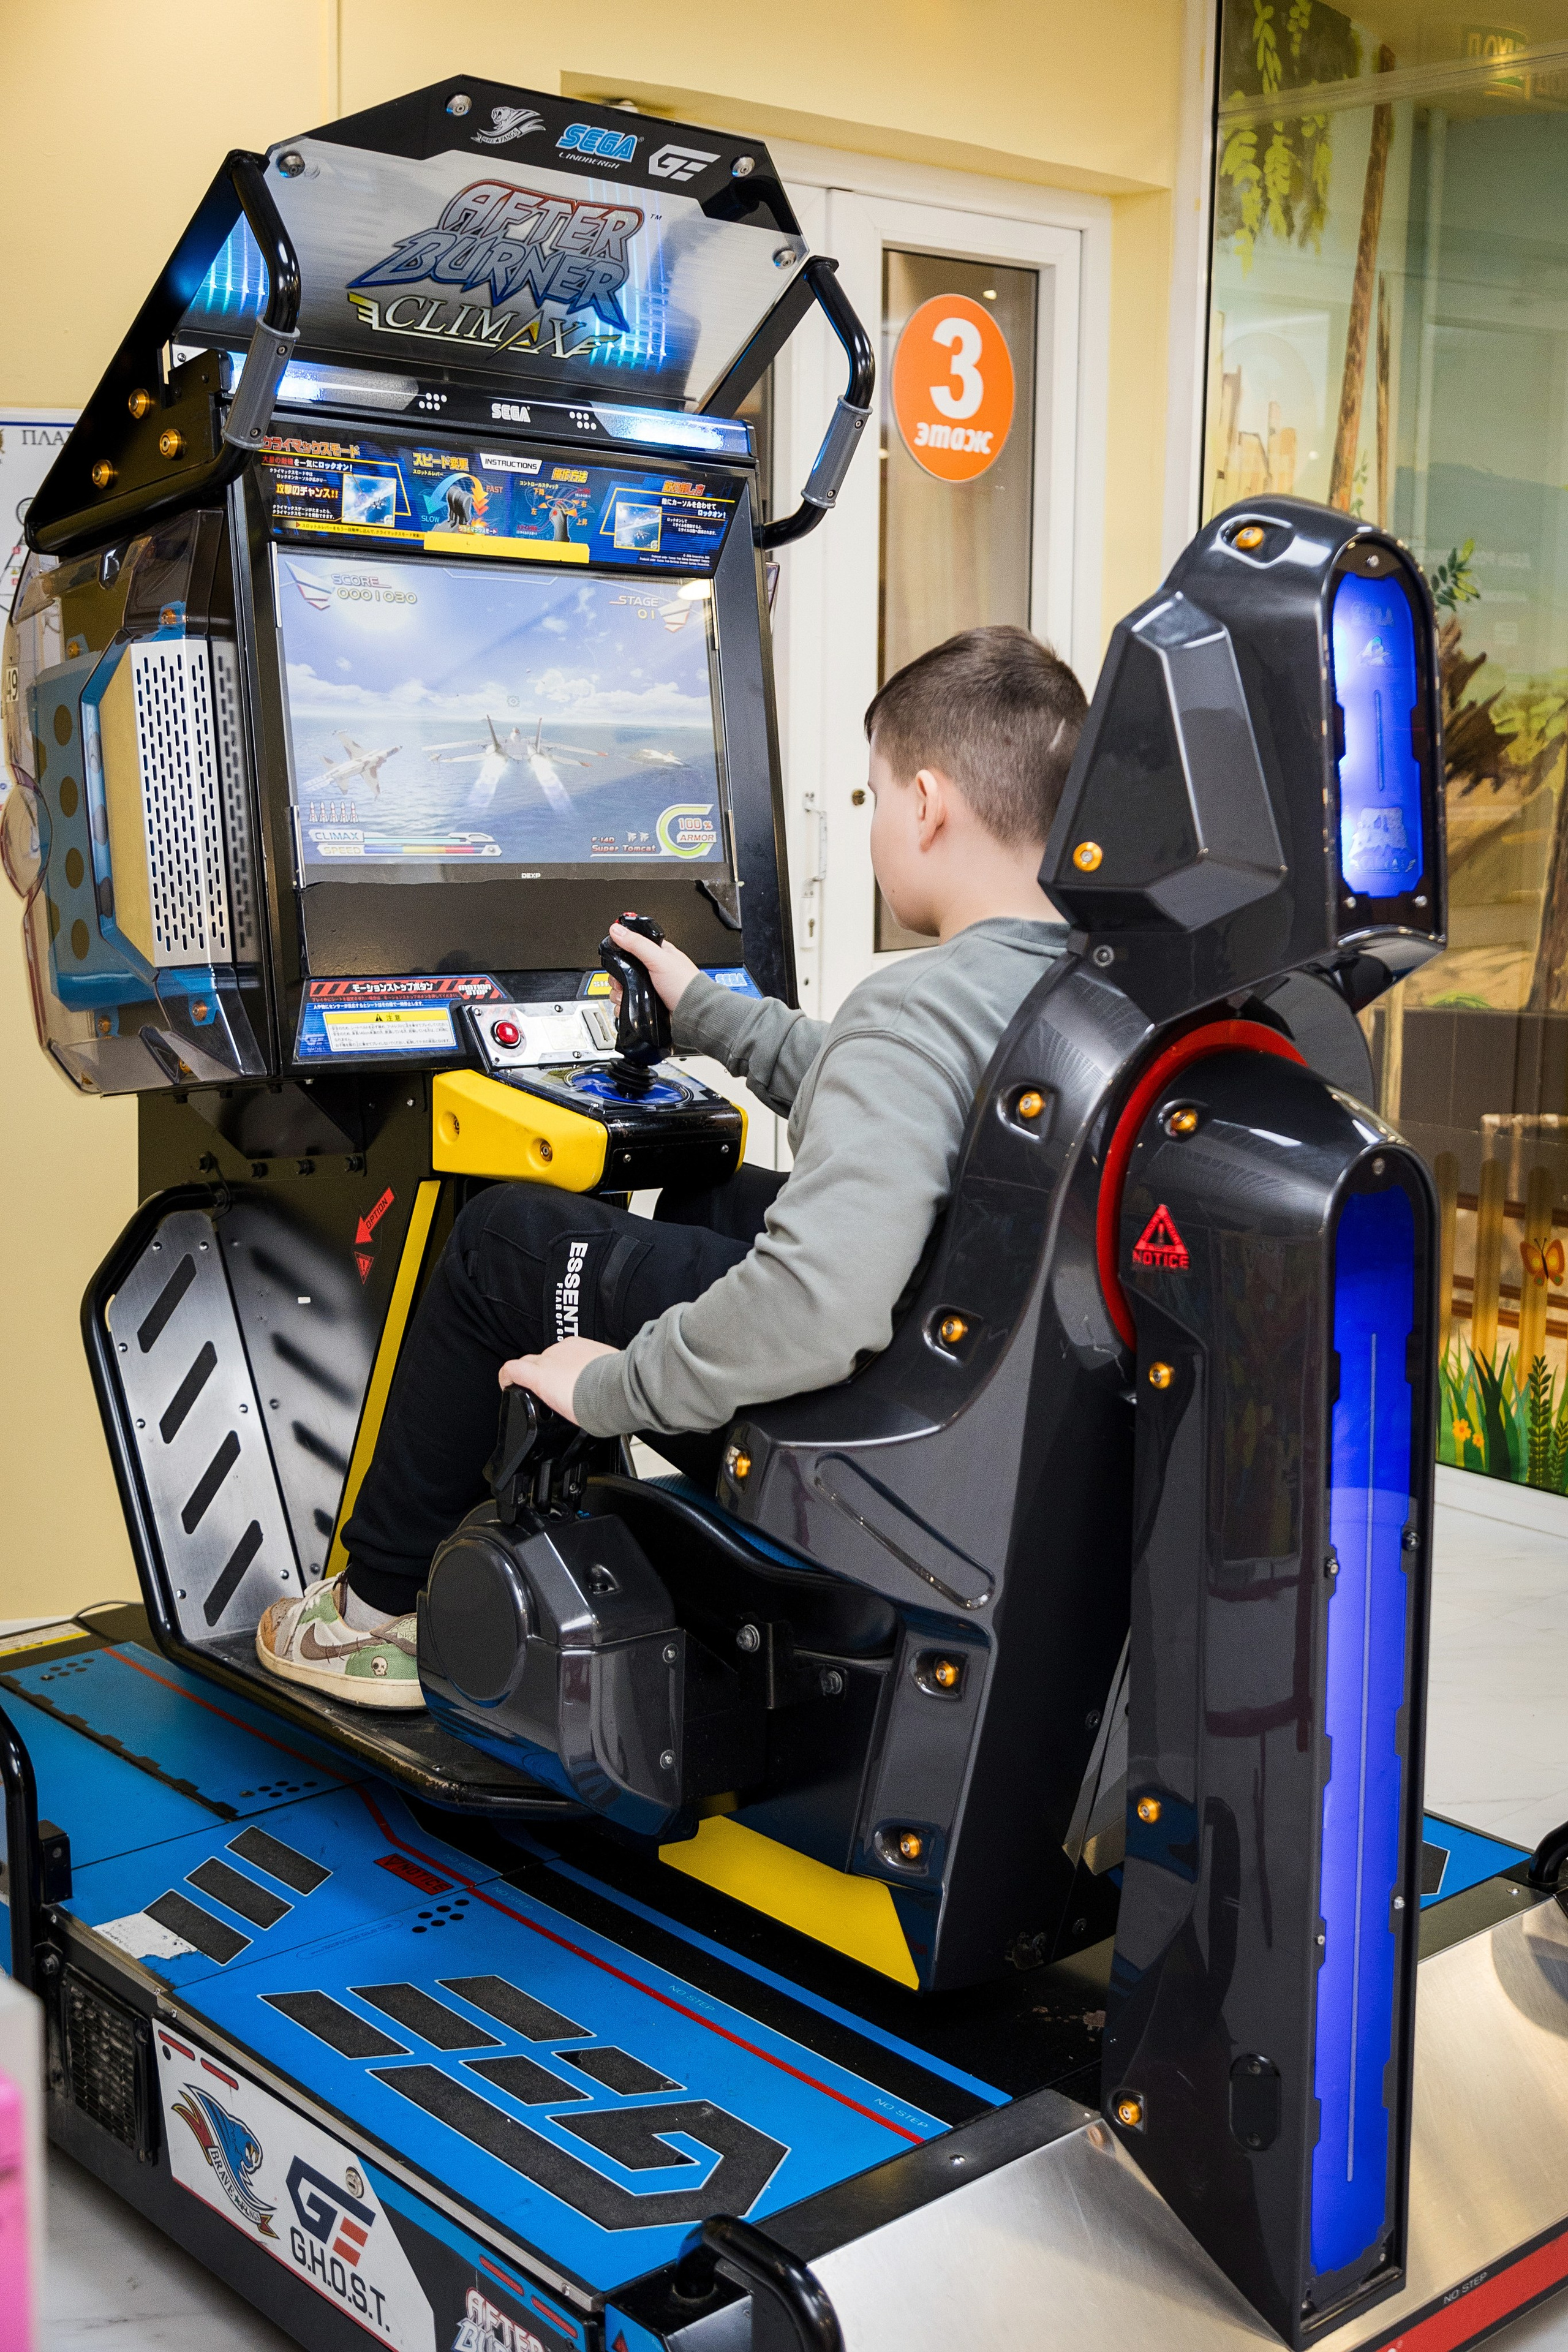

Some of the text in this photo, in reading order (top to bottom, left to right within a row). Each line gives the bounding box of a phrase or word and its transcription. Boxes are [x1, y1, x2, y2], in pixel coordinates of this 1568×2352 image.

[555, 123, 638, 163] SEGA
[559, 151, 620, 170] LINDBERGH
[439, 179, 644, 262] AFTER
[346, 228, 631, 333] BURNER
[374, 293, 591, 360] CLIMAX
[929, 317, 984, 420] 3
[491, 402, 531, 423] SEGA
[21, 429, 72, 446] ПЛА
[263, 435, 360, 458] クライマックスモード
[413, 453, 469, 471] スピード変更
[485, 458, 537, 470] INSTRUCTIONS
[552, 467, 588, 483] 操作方法
[331, 573, 385, 588] SCORE
[616, 595, 659, 607] STAGE
[638, 608, 655, 619] 01
[314, 832, 359, 841] CLIMAX
[323, 846, 362, 854] SPEED
[591, 844, 619, 853] Super
[352, 982, 433, 993] モーションストップボタン
[715, 973, 748, 987] SEGA
[366, 1197, 388, 1229] OPTION
[1132, 1250, 1189, 1270] NOTICE
[555, 1282, 564, 1310] FEAR
[564, 1242, 588, 1337] ESSENT
[556, 1313, 563, 1326] OF
[401, 1861, 450, 1892] NOTICE
[668, 1985, 715, 2011] NO STEP
[873, 2098, 929, 2128] NO STEP
[210, 2149, 235, 2197] BRAVE
[290, 2225, 391, 2333] G.H.O.S.T.
[1442, 2271, 1488, 2305] NO STEP
[466, 2286, 545, 2352] AFTER
